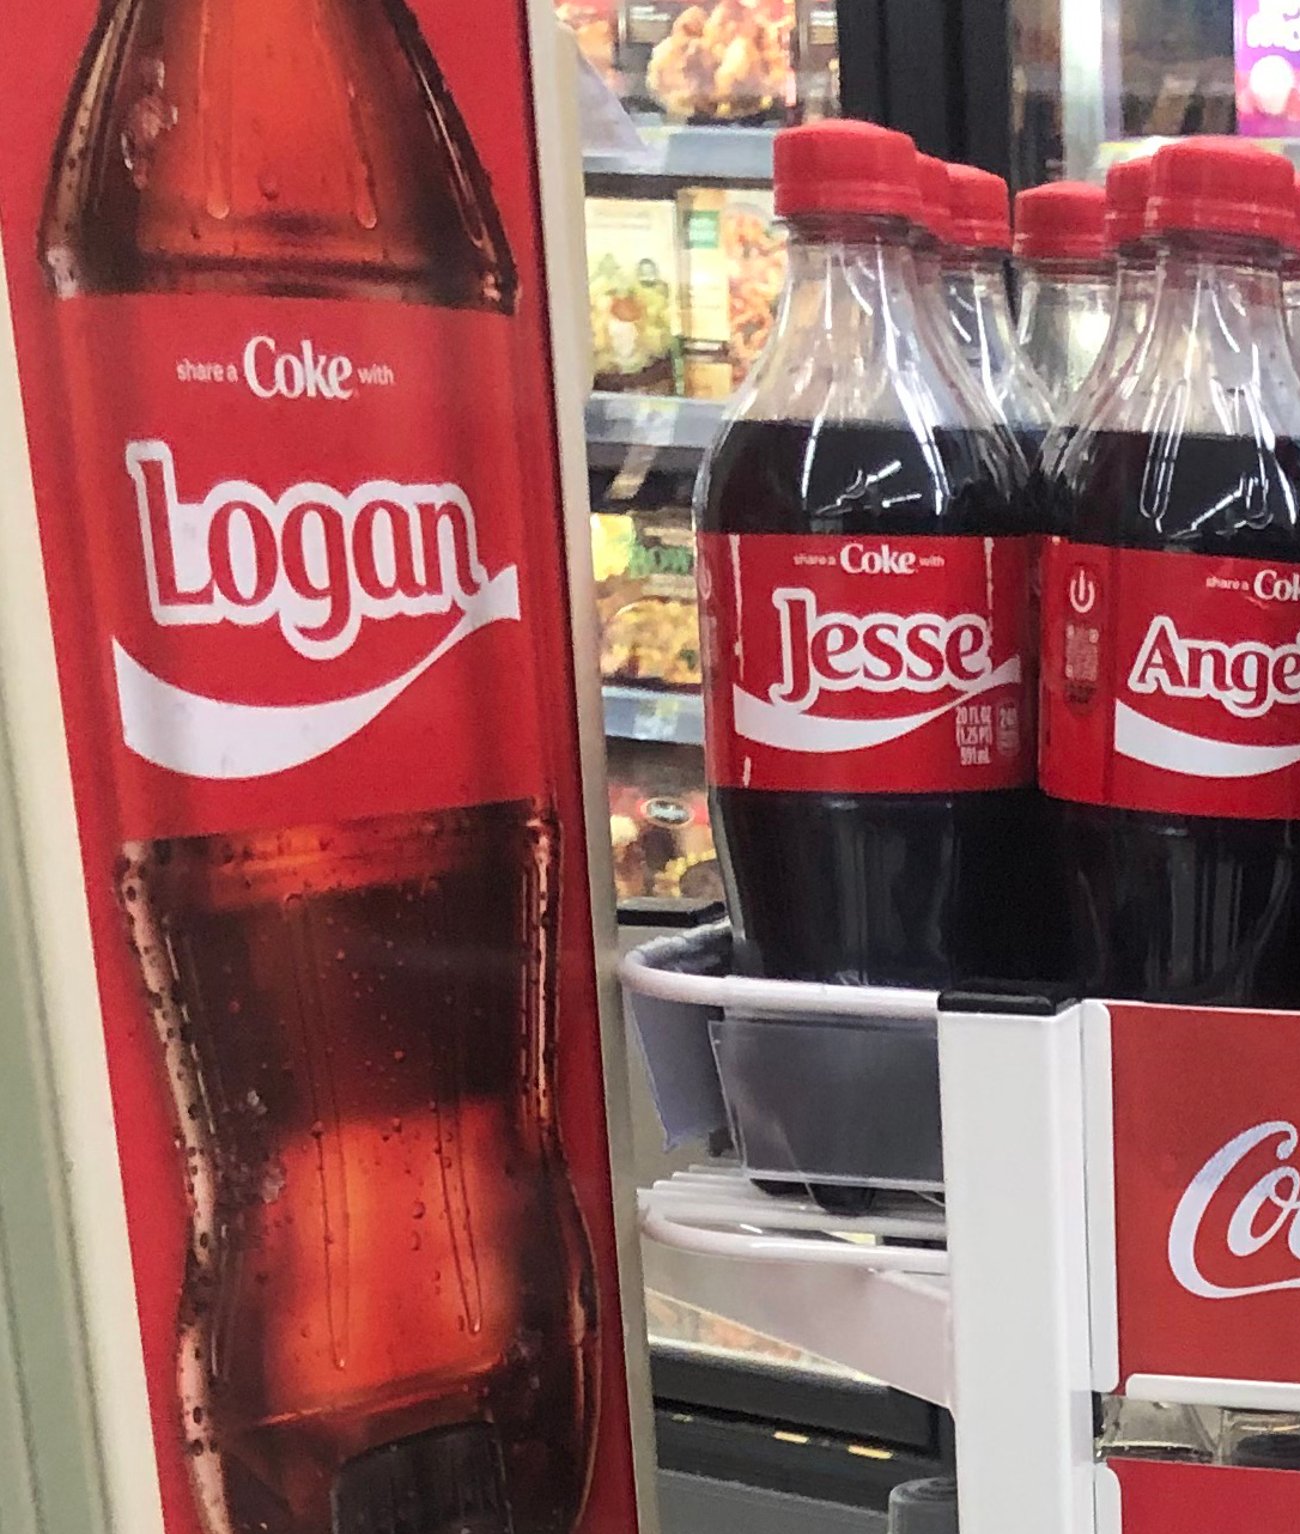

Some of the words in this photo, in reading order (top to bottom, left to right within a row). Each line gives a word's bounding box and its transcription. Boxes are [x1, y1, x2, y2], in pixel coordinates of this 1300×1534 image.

[243, 335, 353, 399] Coke
[359, 365, 394, 386] with
[126, 440, 482, 660] Logan
[840, 543, 918, 574] Coke
[769, 587, 992, 714] Jesse
